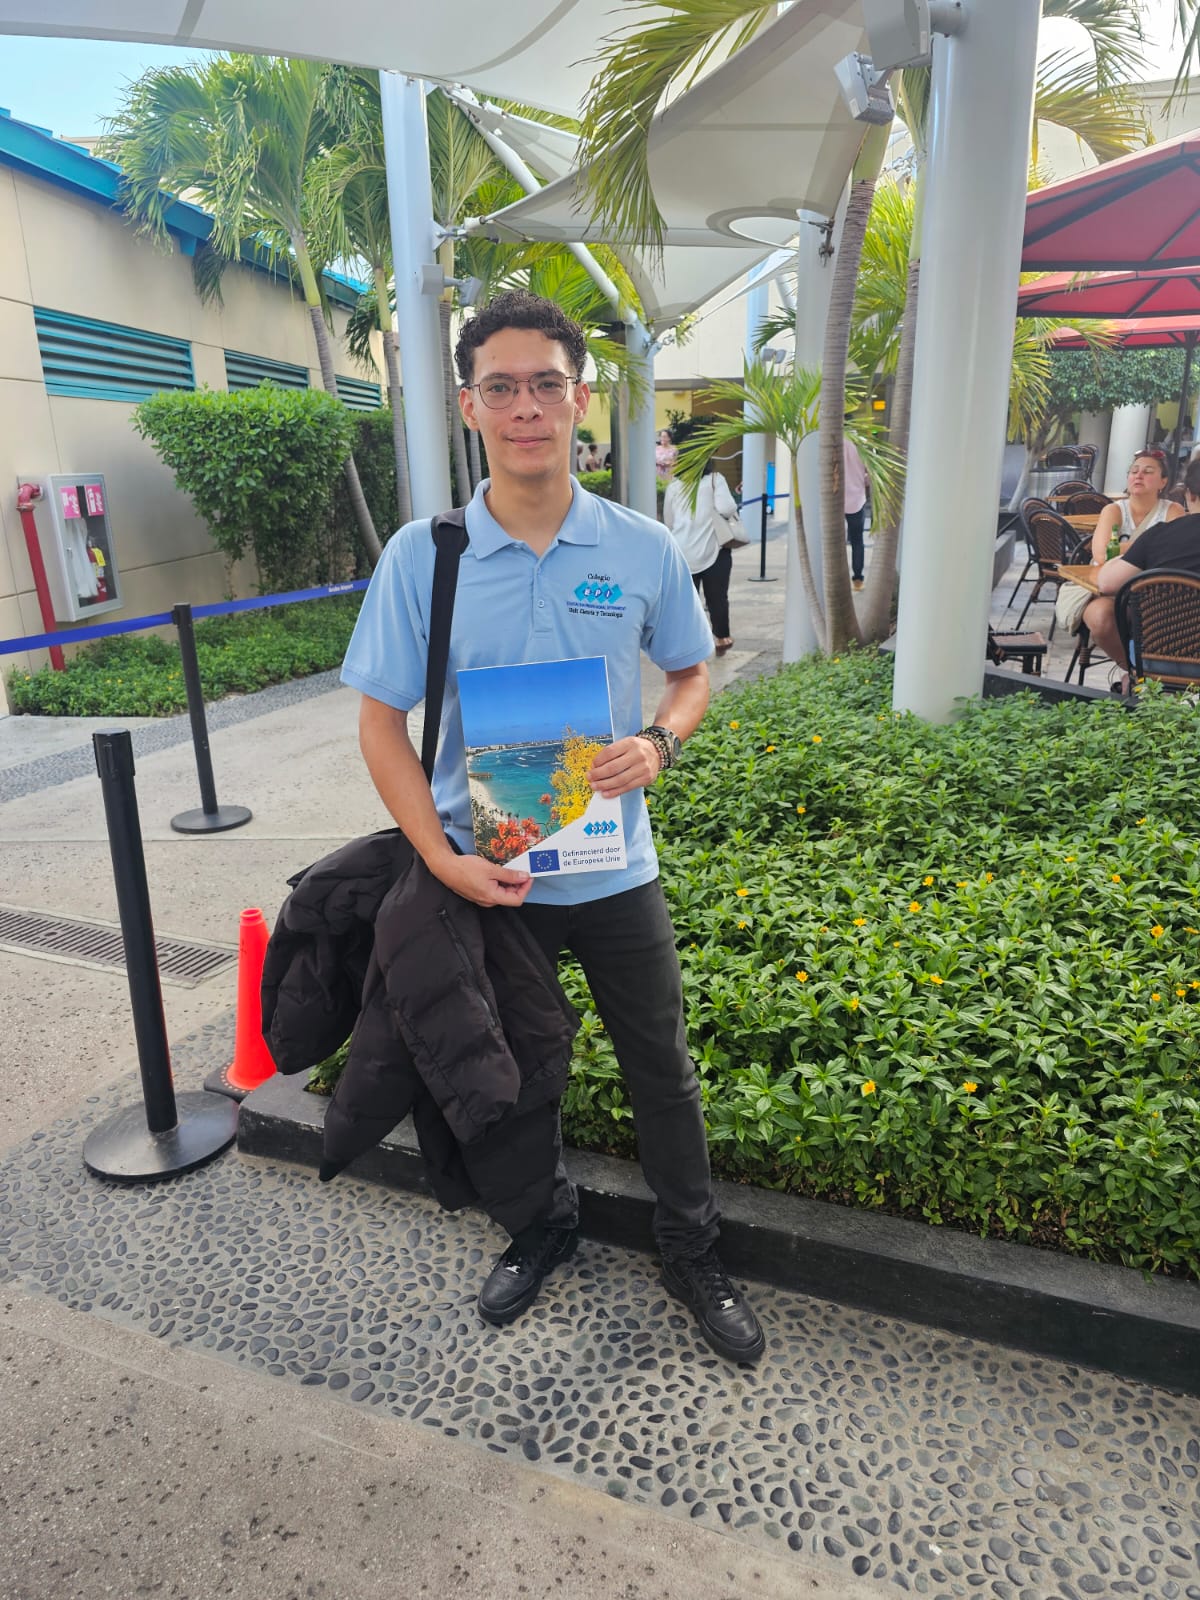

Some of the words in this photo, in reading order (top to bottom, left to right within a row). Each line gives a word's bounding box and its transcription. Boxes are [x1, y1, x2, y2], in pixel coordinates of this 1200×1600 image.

[587, 573, 611, 582] Colegio
[562, 847, 604, 858] Gefinancierd
[605, 846, 621, 854] door
[573, 857, 604, 867] Europese
